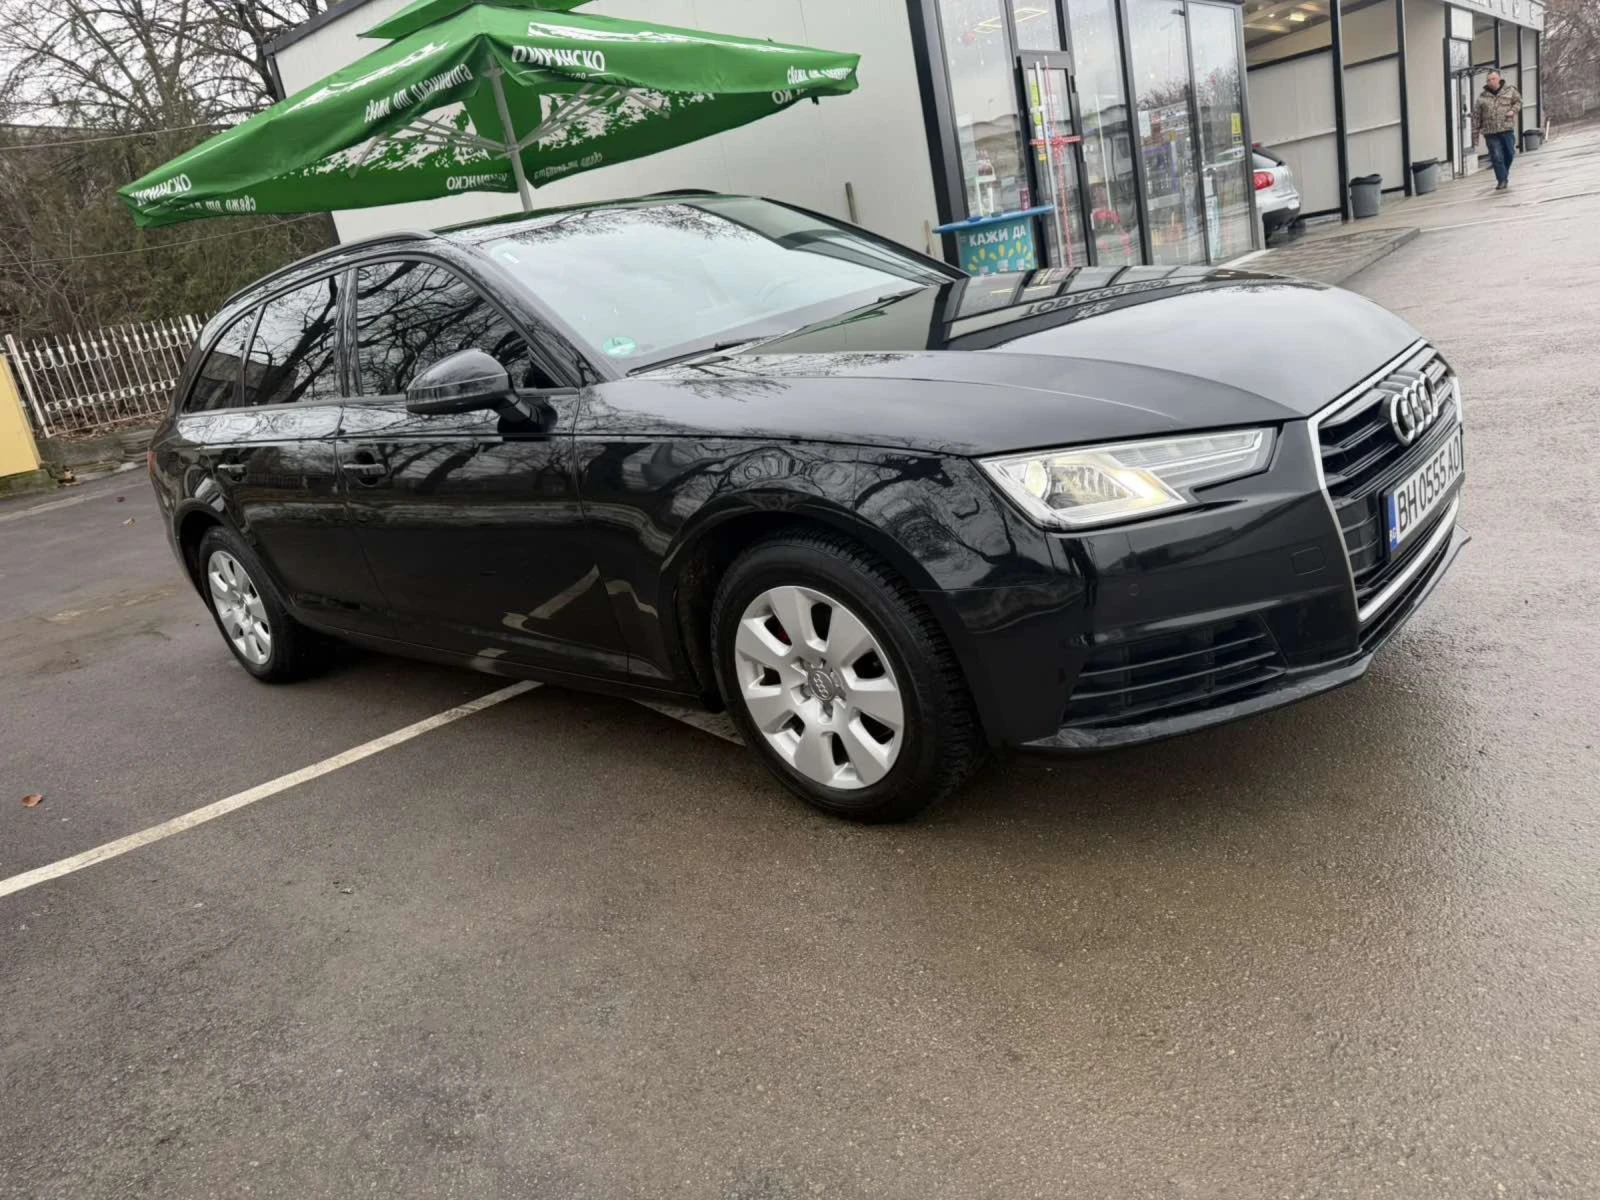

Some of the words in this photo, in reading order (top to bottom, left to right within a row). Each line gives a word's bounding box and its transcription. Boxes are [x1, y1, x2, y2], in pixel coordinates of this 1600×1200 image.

[511, 45, 605, 72] ПИРИНСКО
[969, 228, 1009, 247] КАЖИ
[1012, 224, 1027, 240] ДА
[1398, 479, 1418, 532] BH
[1419, 448, 1447, 511] 0555
